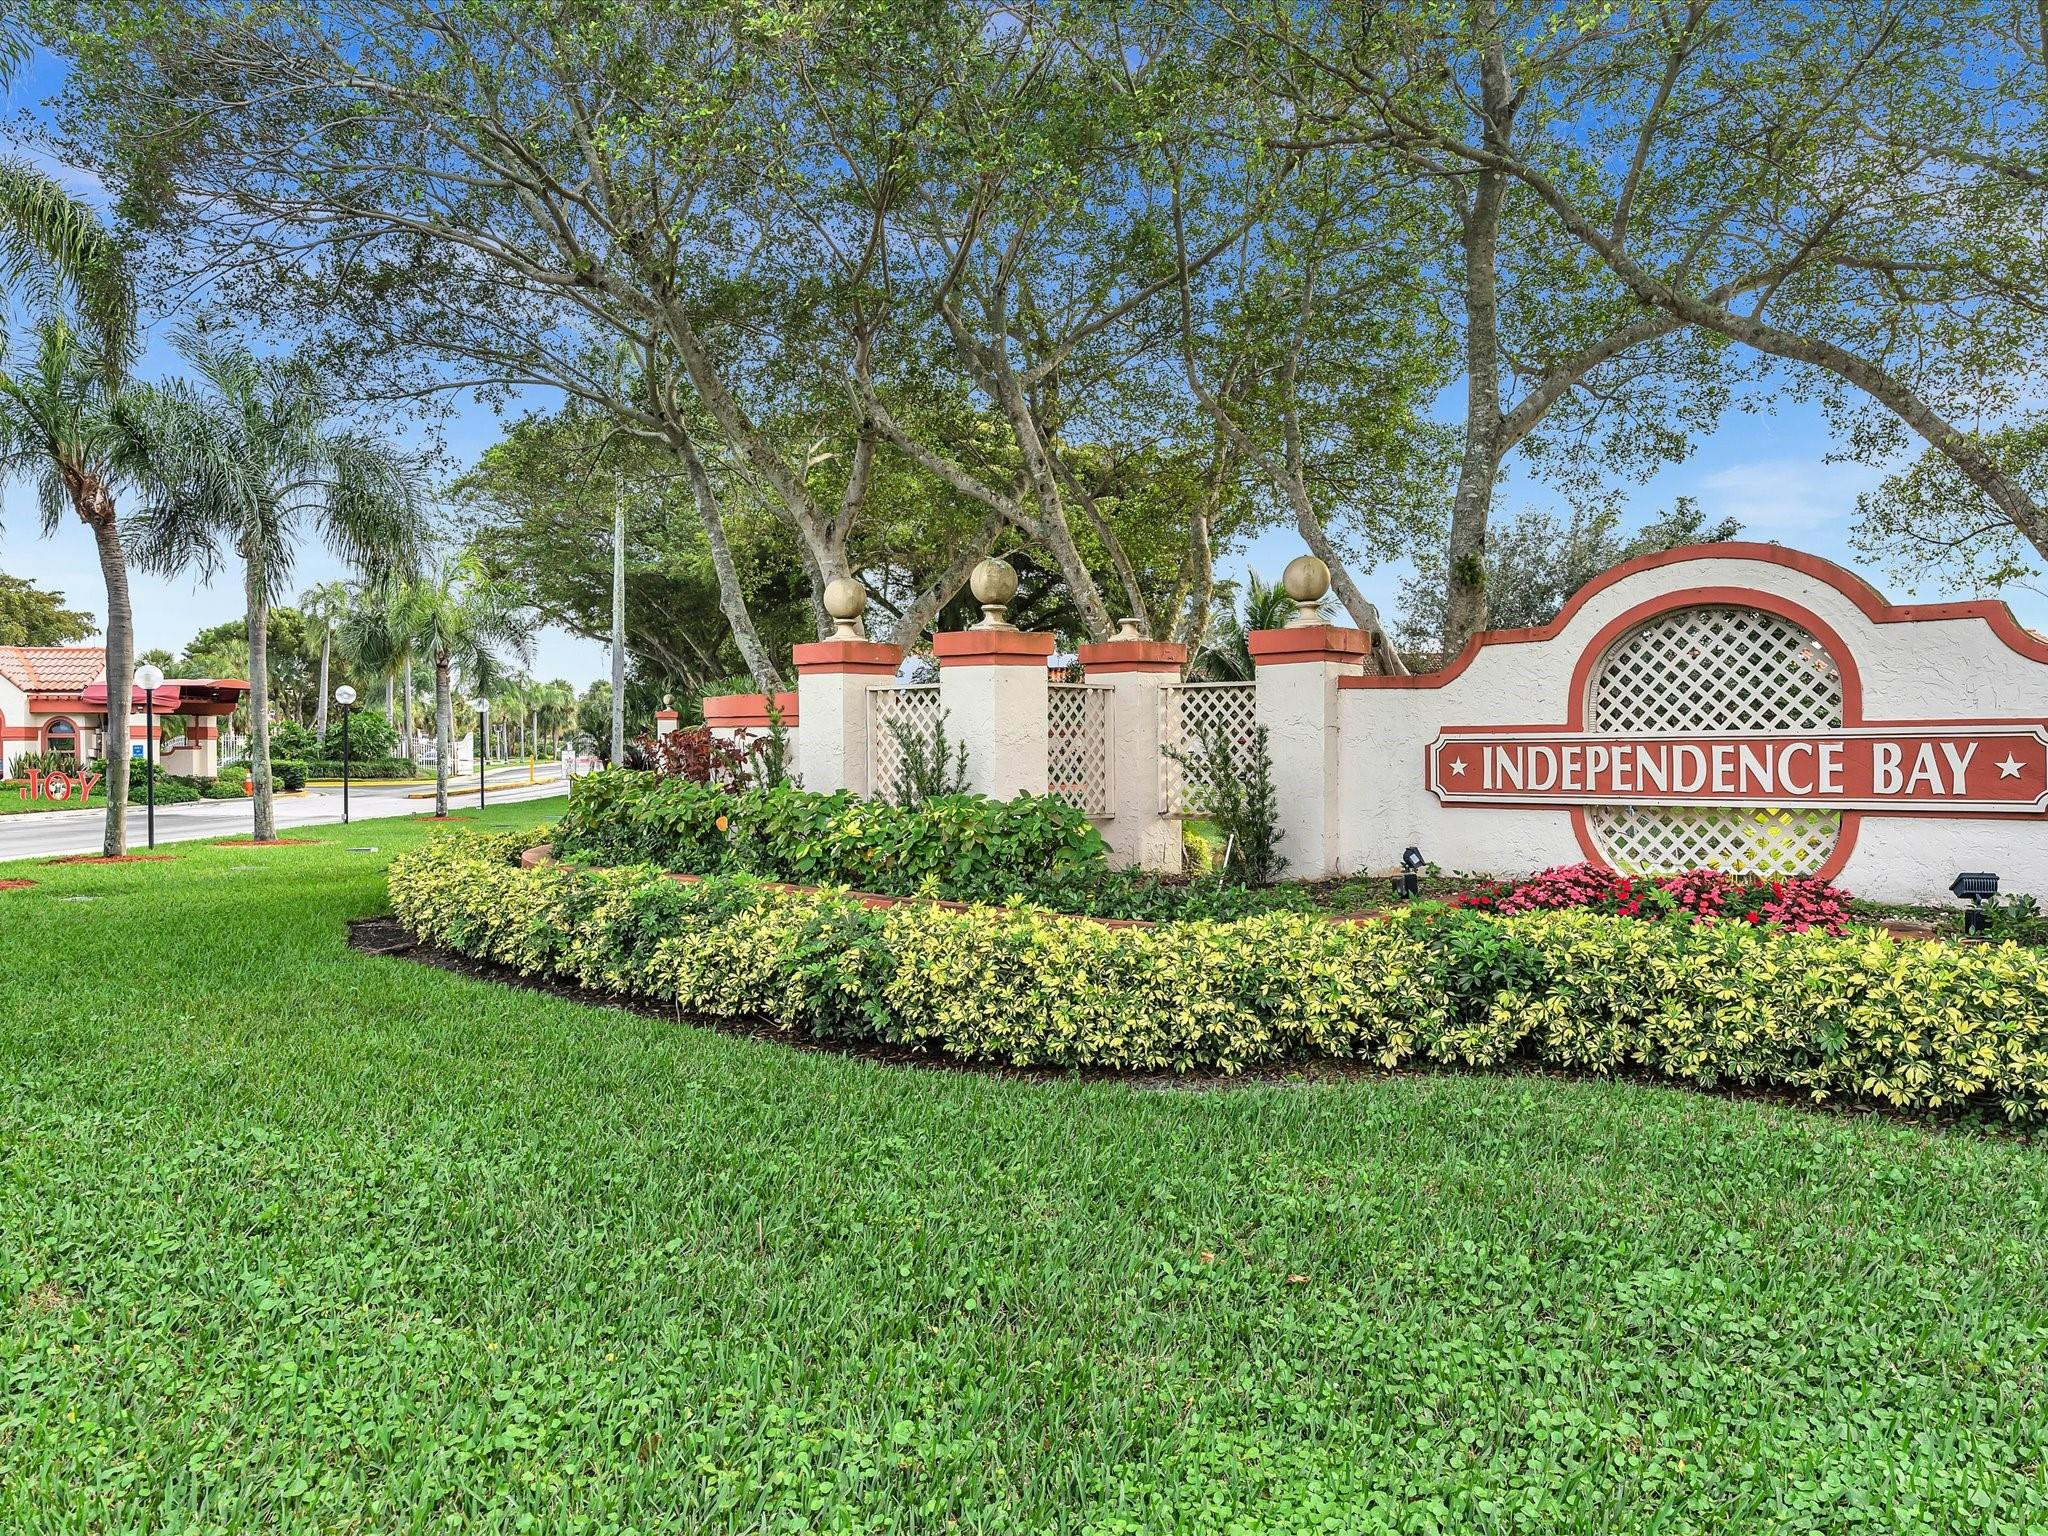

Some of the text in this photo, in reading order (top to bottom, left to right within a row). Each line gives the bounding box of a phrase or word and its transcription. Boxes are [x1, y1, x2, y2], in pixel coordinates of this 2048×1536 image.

[20, 768, 102, 803] JOY
[1482, 742, 1979, 795] INDEPENDENCE BAY
